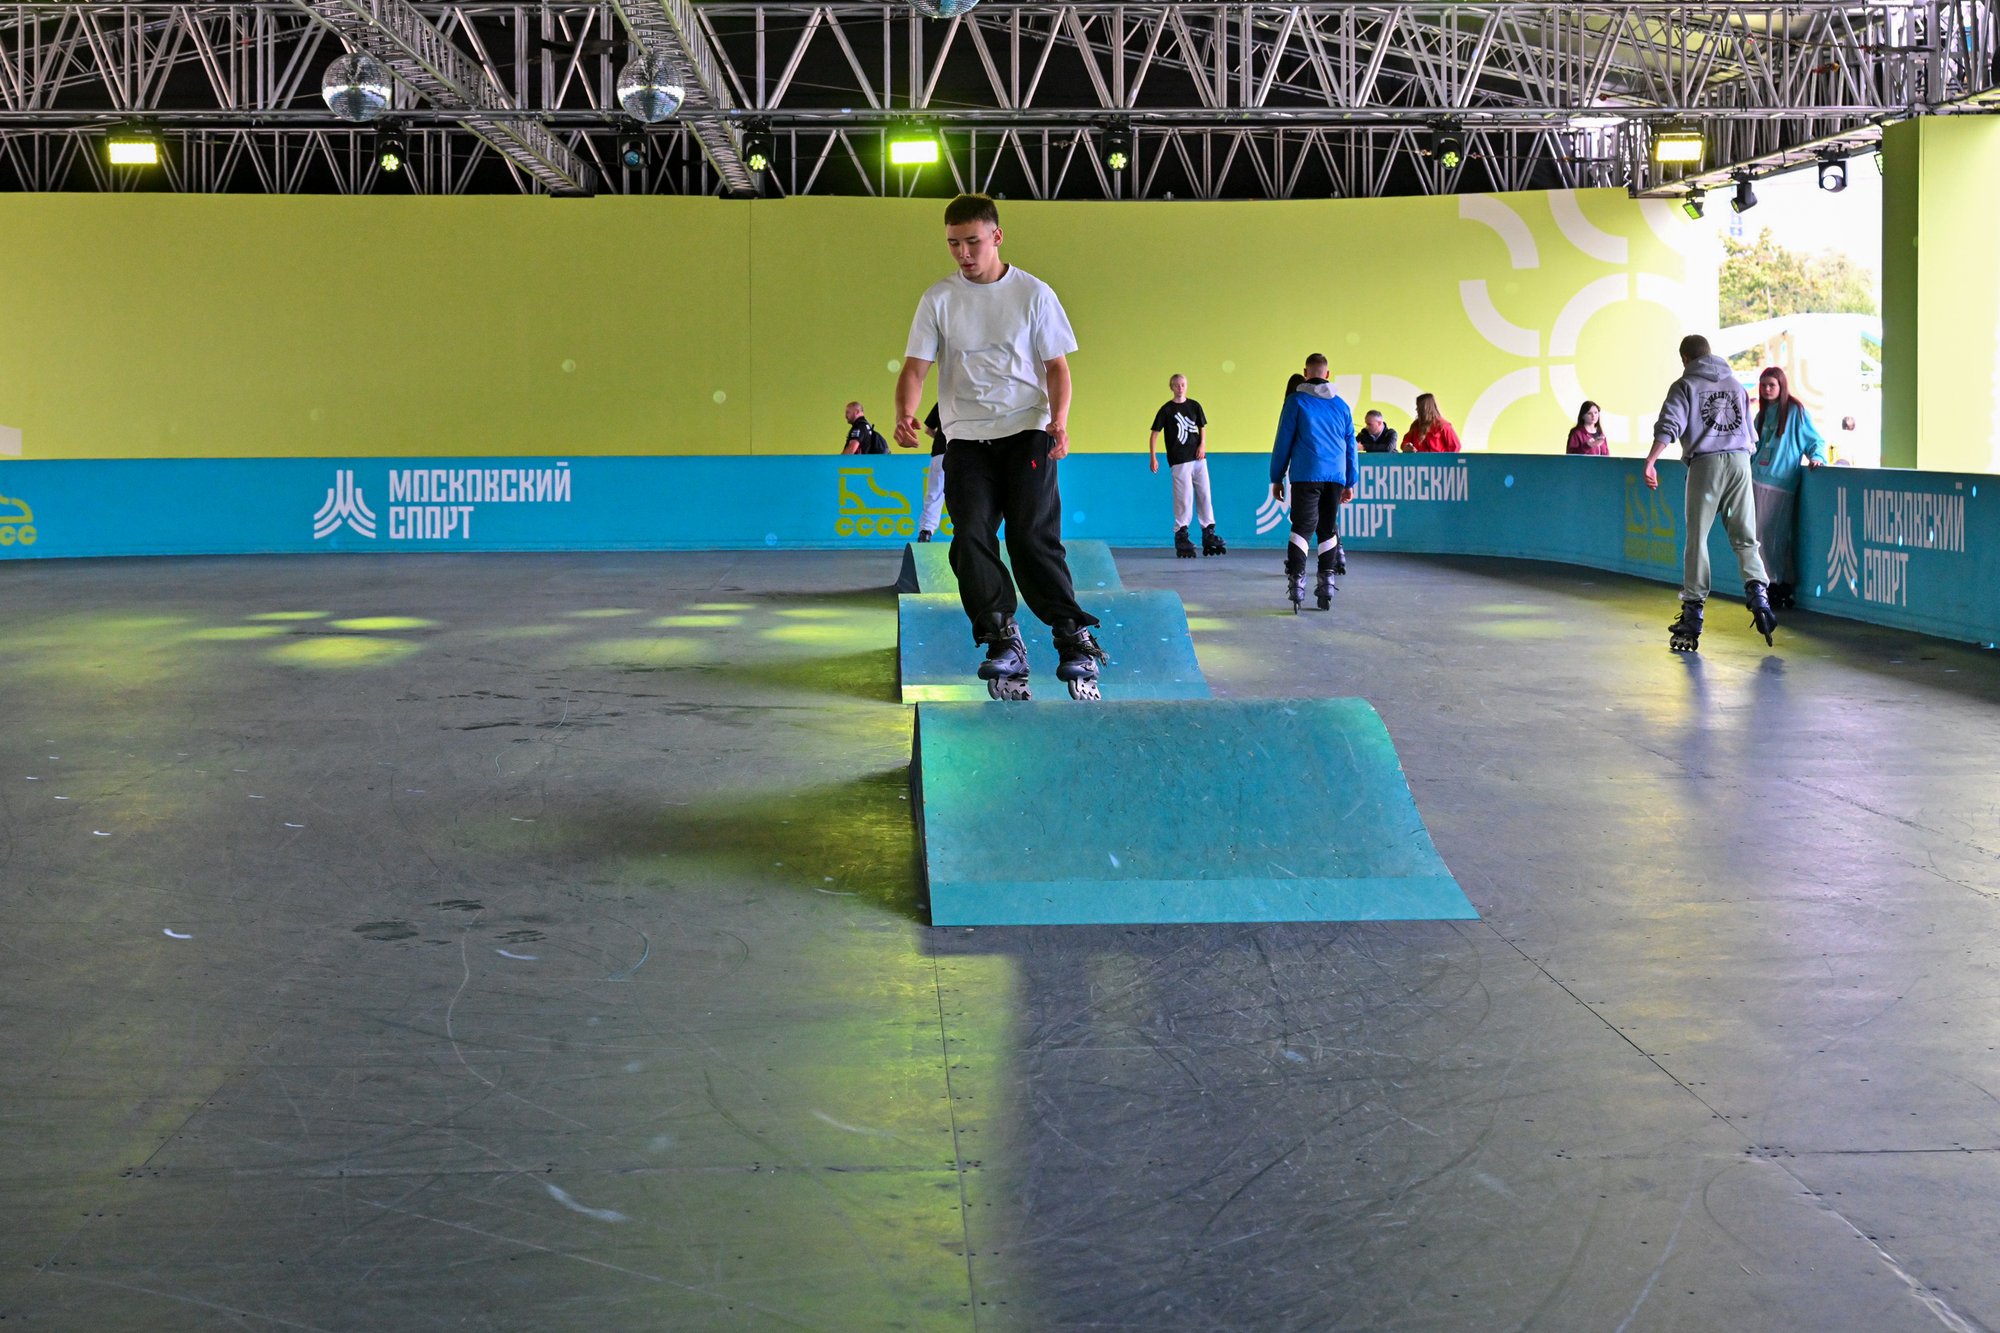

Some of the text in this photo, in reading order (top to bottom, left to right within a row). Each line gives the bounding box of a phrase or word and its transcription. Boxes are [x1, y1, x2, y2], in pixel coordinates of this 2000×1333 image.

[389, 461, 571, 502] МОСКОВСКИЙ
[1353, 458, 1468, 501] СКОВСКИЙ
[389, 506, 474, 539] СПОРТ
[1336, 503, 1396, 538] ПОРТ
[1864, 482, 1965, 552] МОСКОВСКИЙ
[1864, 548, 1909, 607] СПОРТ
